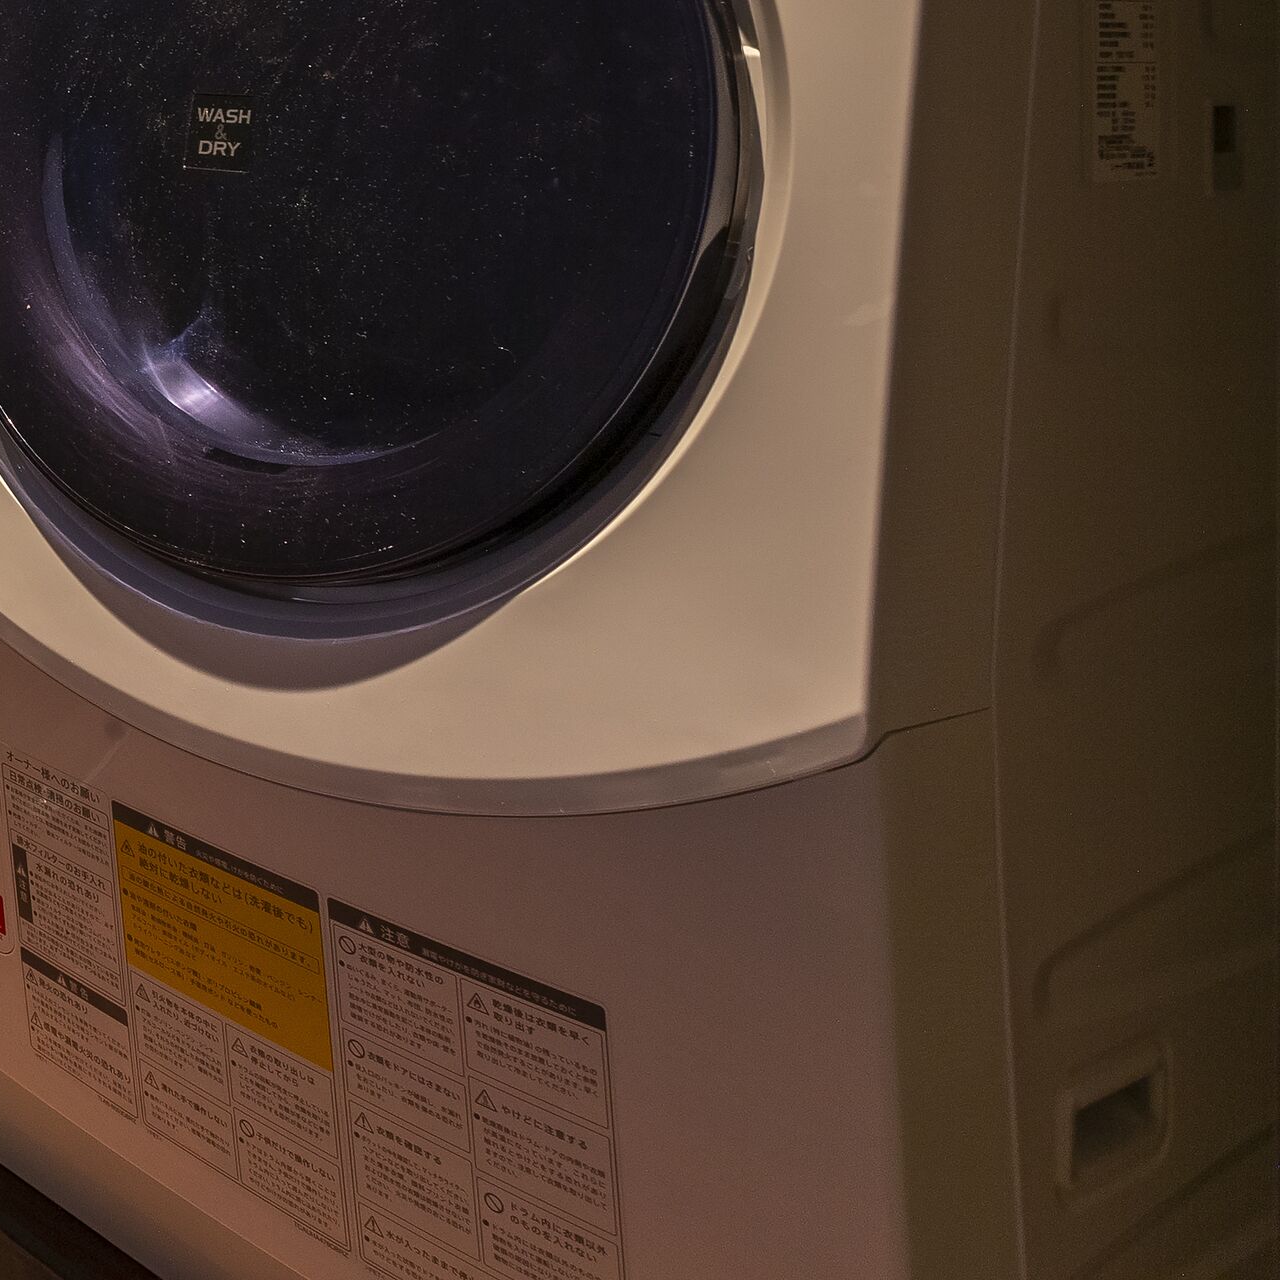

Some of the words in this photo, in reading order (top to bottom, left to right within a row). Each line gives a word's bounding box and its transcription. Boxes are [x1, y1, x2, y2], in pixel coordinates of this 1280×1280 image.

[198, 107, 251, 124] WASH
[215, 124, 227, 140] &
[198, 140, 240, 156] DRY
[6, 750, 99, 805] オーナー様へのお願い
[16, 835, 105, 891] 排水フィルターのお手入れ
[35, 861, 98, 904] 水漏れの恐れあり
[380, 925, 409, 949] 注意
[360, 954, 424, 988] 衣類を入れない
[492, 998, 589, 1045] 乾燥後は衣類を早く
[493, 1011, 534, 1036] 取り出す
[250, 1043, 314, 1086] 衣類の取り出しは
[251, 1055, 298, 1088] 停止してから
[367, 1051, 459, 1101] 衣類をドアにはさまない
[376, 1126, 441, 1165] 衣類を確認する
[502, 1105, 587, 1150] やけどに注意する
[256, 1131, 335, 1183] 子供だけで操作しない
[510, 1214, 596, 1263] のものを入れない
[511, 1201, 607, 1256] ドラム内に衣類以外
